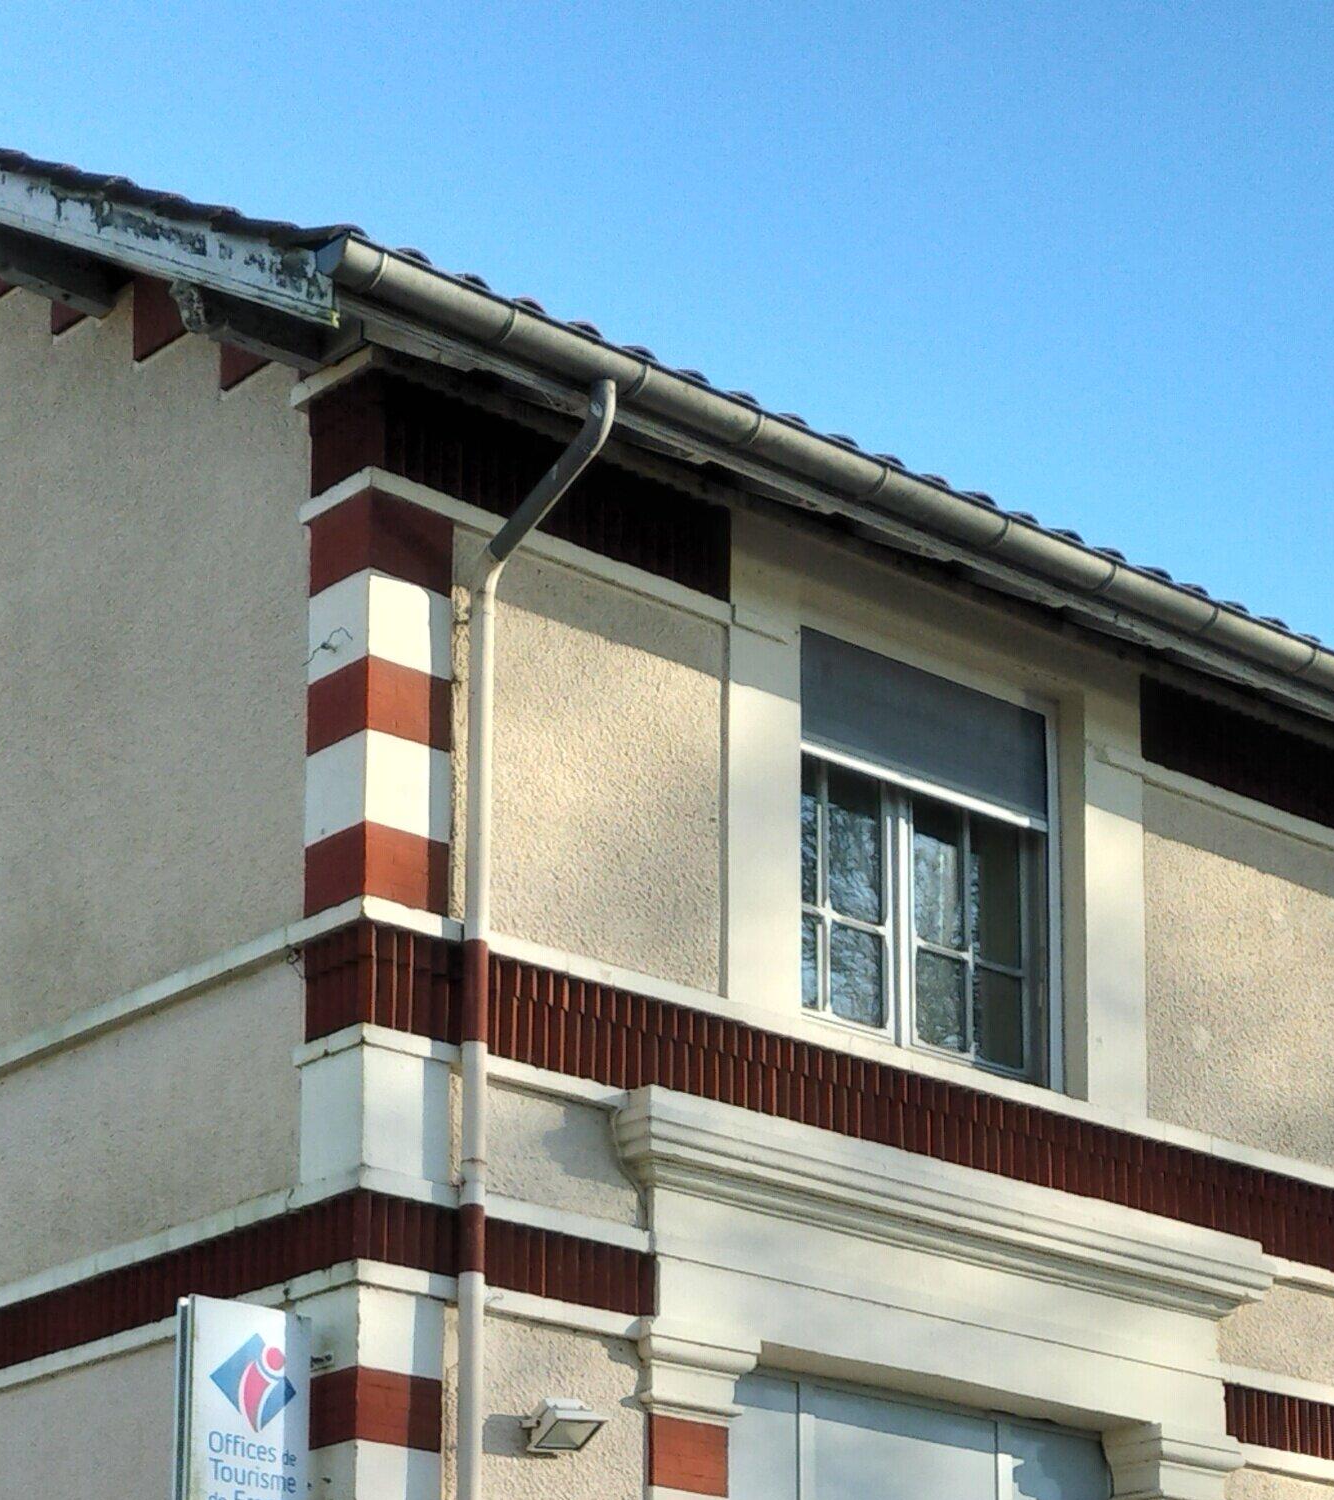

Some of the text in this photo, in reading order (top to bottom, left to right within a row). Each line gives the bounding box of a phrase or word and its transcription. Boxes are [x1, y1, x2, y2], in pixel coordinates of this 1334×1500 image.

[209, 1431, 297, 1467] Offices de
[209, 1457, 296, 1494] Tourisme
